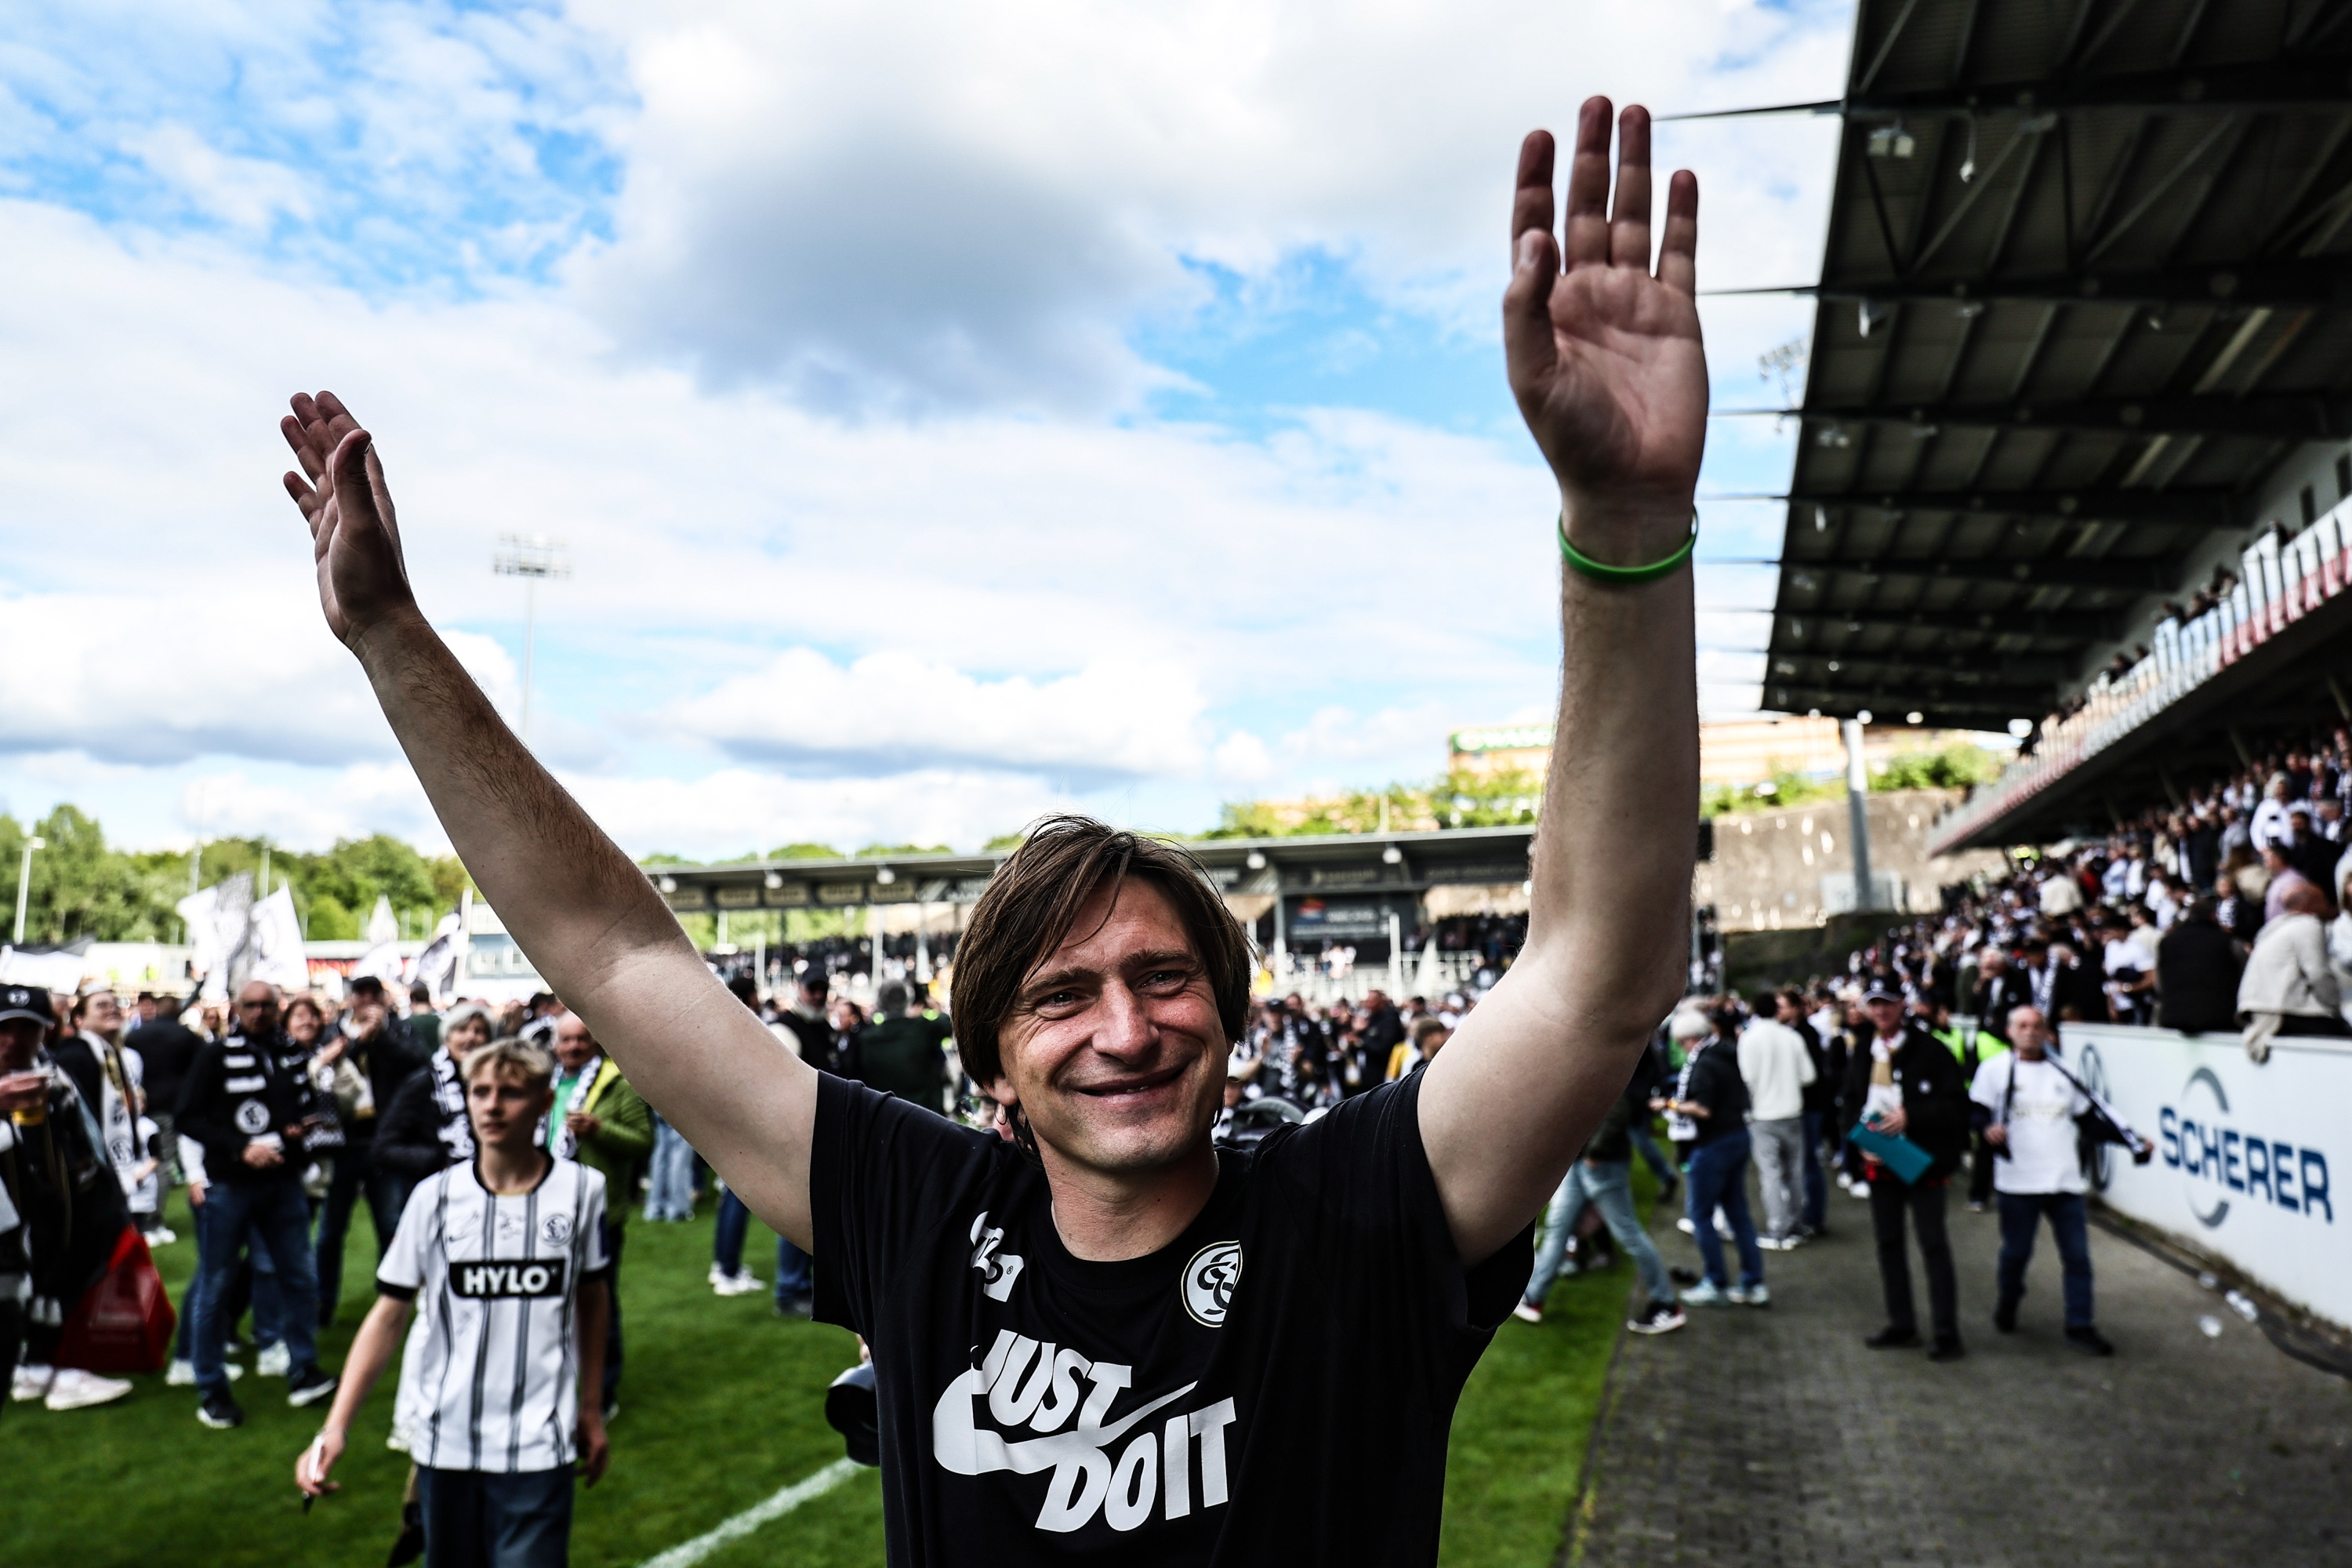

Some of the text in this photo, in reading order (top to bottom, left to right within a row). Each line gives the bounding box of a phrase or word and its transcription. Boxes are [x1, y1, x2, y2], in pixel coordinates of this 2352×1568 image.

[2159, 1105, 2334, 1224] SCHERER
[463, 1266, 550, 1294] HYLO
[971, 1329, 1132, 1433] JUST
